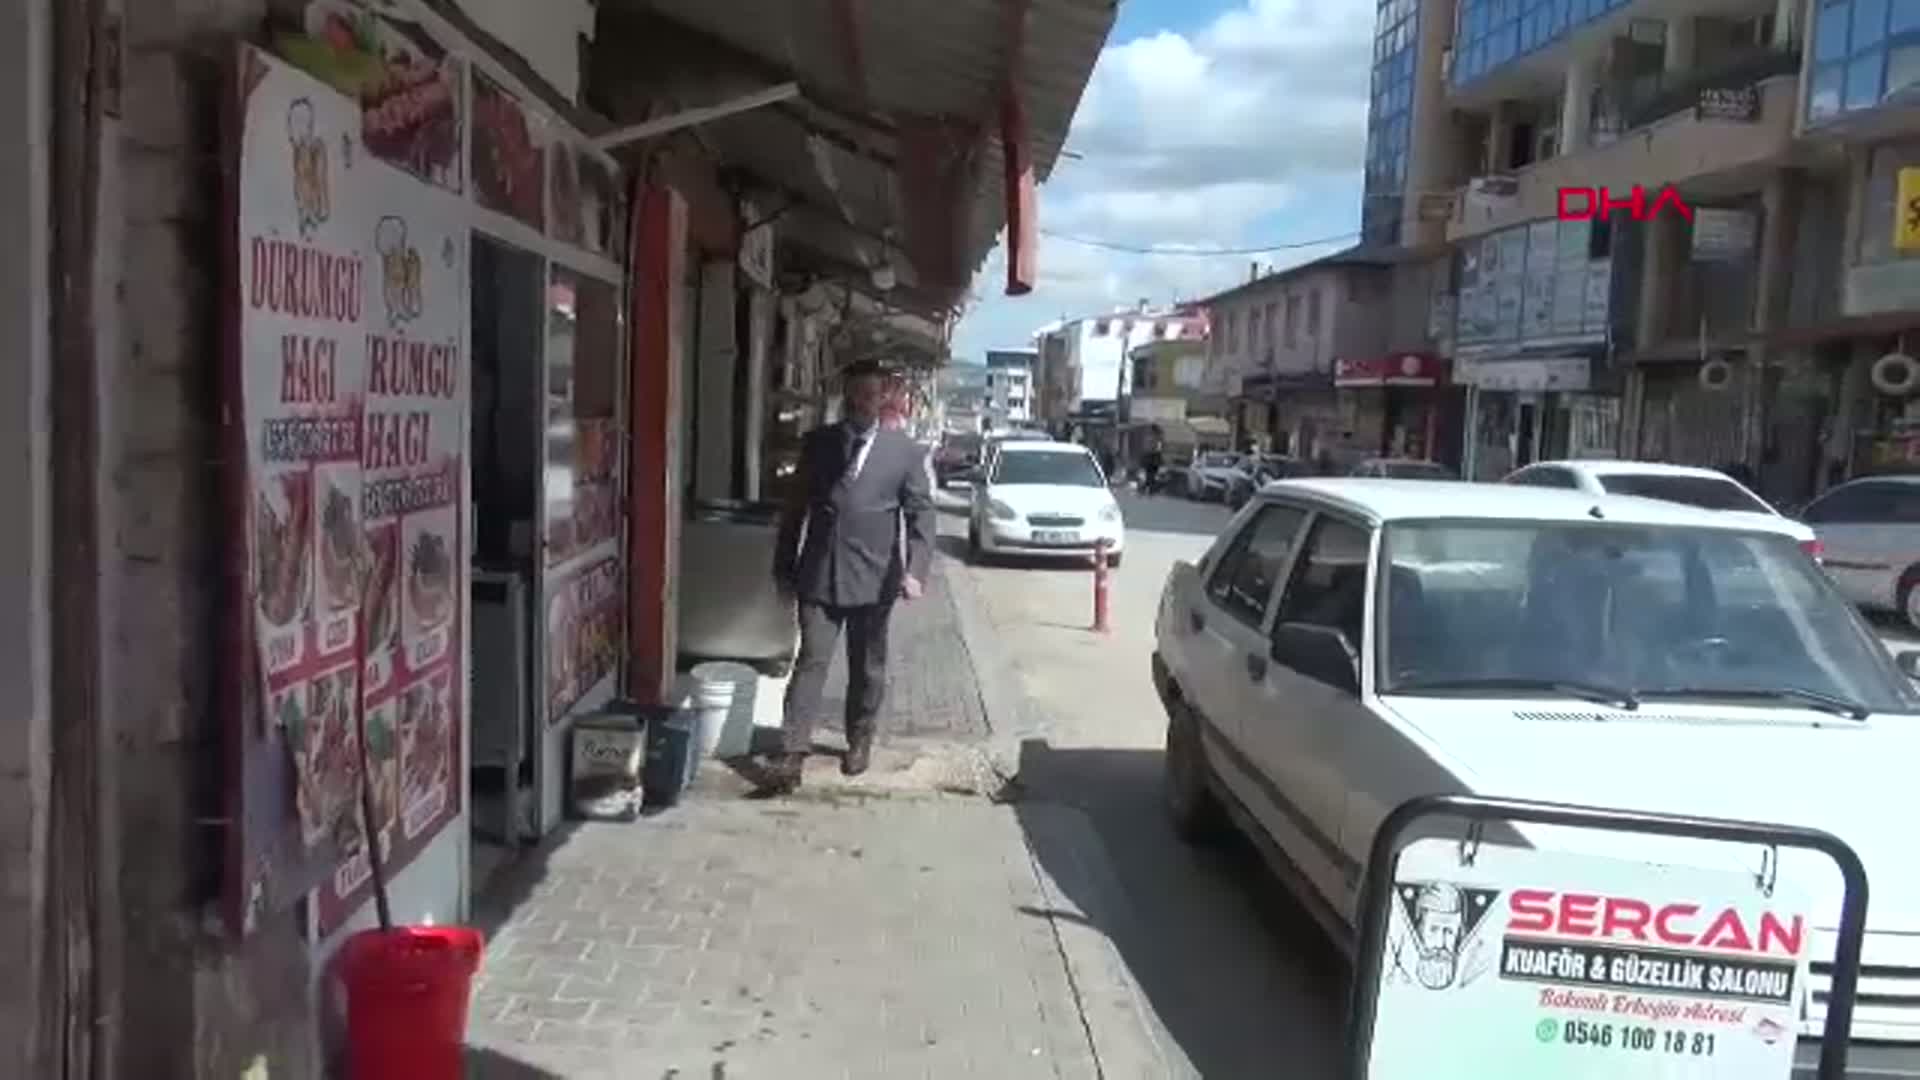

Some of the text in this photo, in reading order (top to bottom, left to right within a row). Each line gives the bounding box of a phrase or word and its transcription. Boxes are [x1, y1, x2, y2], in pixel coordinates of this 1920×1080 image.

[1507, 889, 1803, 955] SERCAN
[1505, 946, 1788, 997] KUAFÖR & GÜZELLİK SALONU
[1564, 1020, 1714, 1057] 0546 100 18 81
